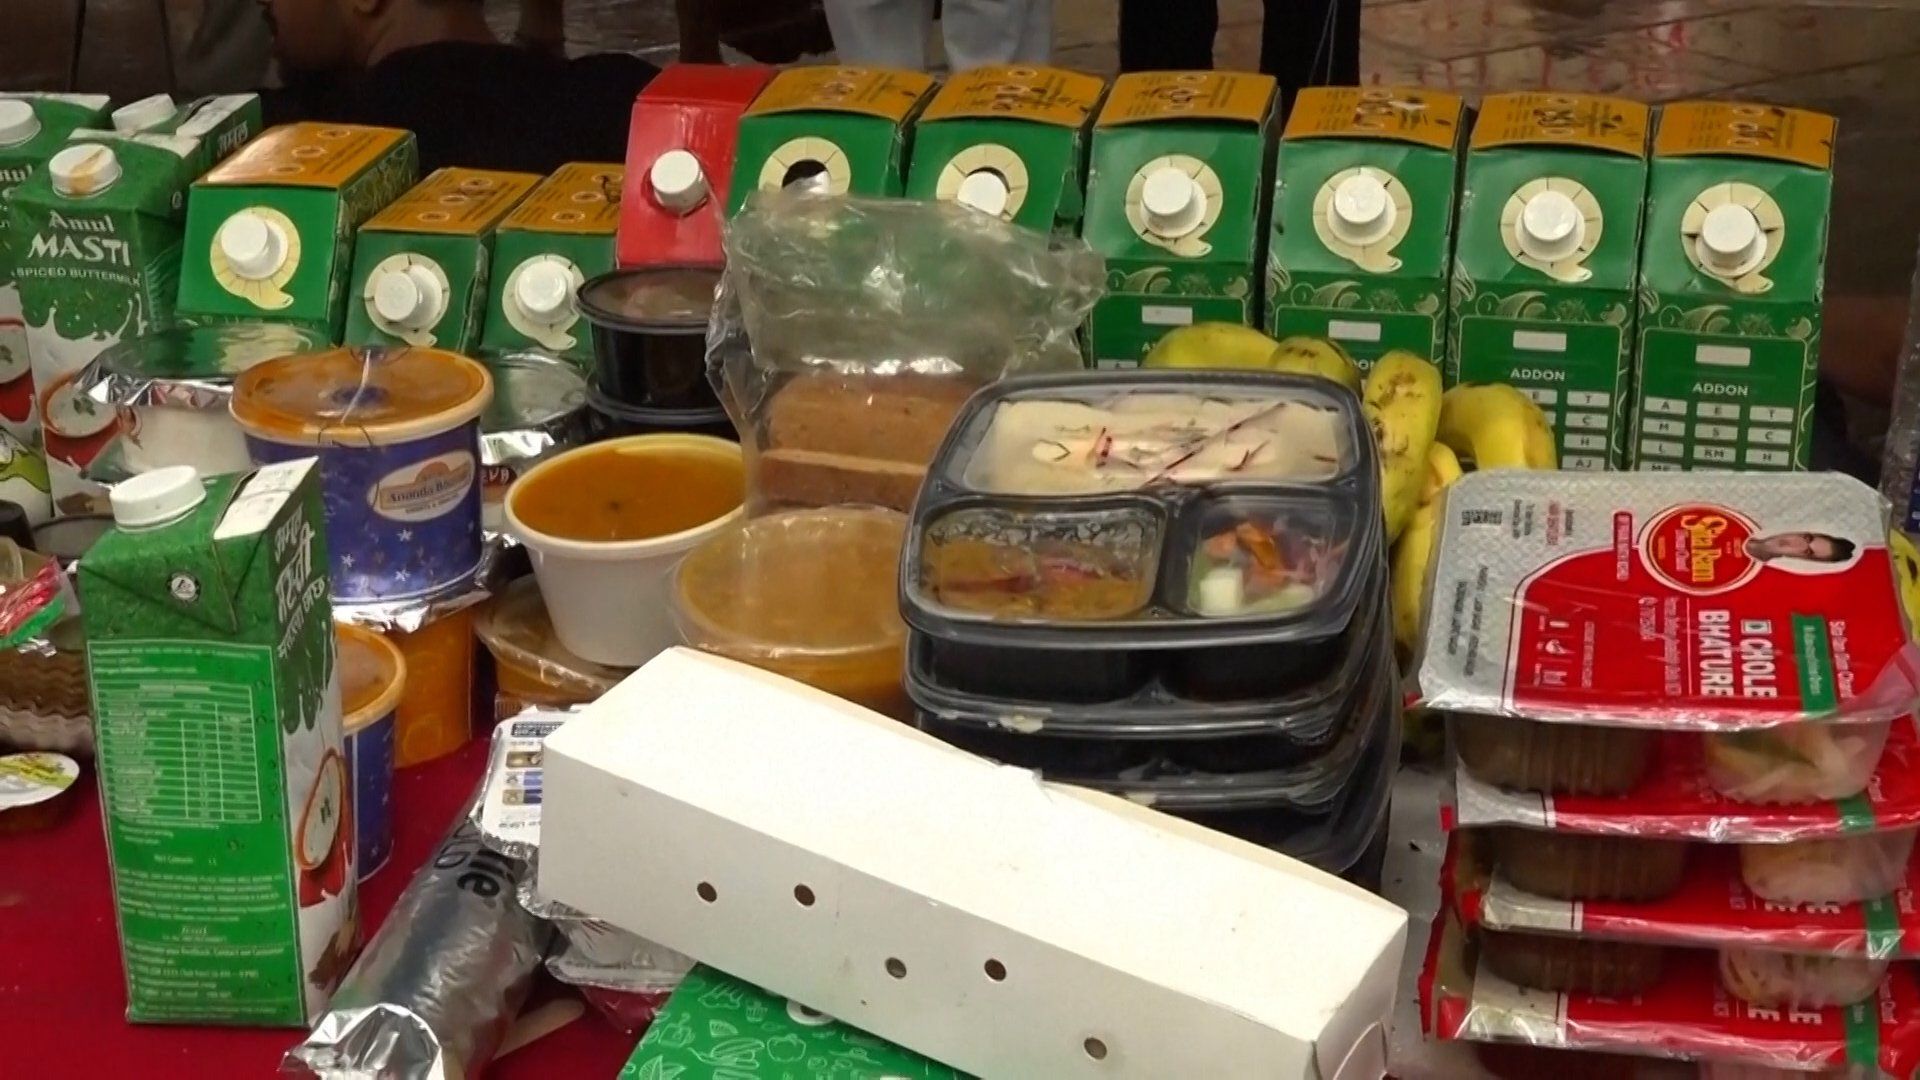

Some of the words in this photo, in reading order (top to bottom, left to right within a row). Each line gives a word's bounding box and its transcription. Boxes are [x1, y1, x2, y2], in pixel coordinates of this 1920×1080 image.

[49, 209, 115, 233] Amul
[27, 232, 131, 267] MASTI
[16, 267, 66, 277] SPICED
[1510, 367, 1565, 381] ADDON
[1691, 382, 1748, 397] ADDON
[1680, 515, 1727, 547] Sita
[1691, 549, 1722, 582] Ram
[1697, 609, 1732, 697] BHATURE
[1740, 639, 1777, 698] CHOLE
